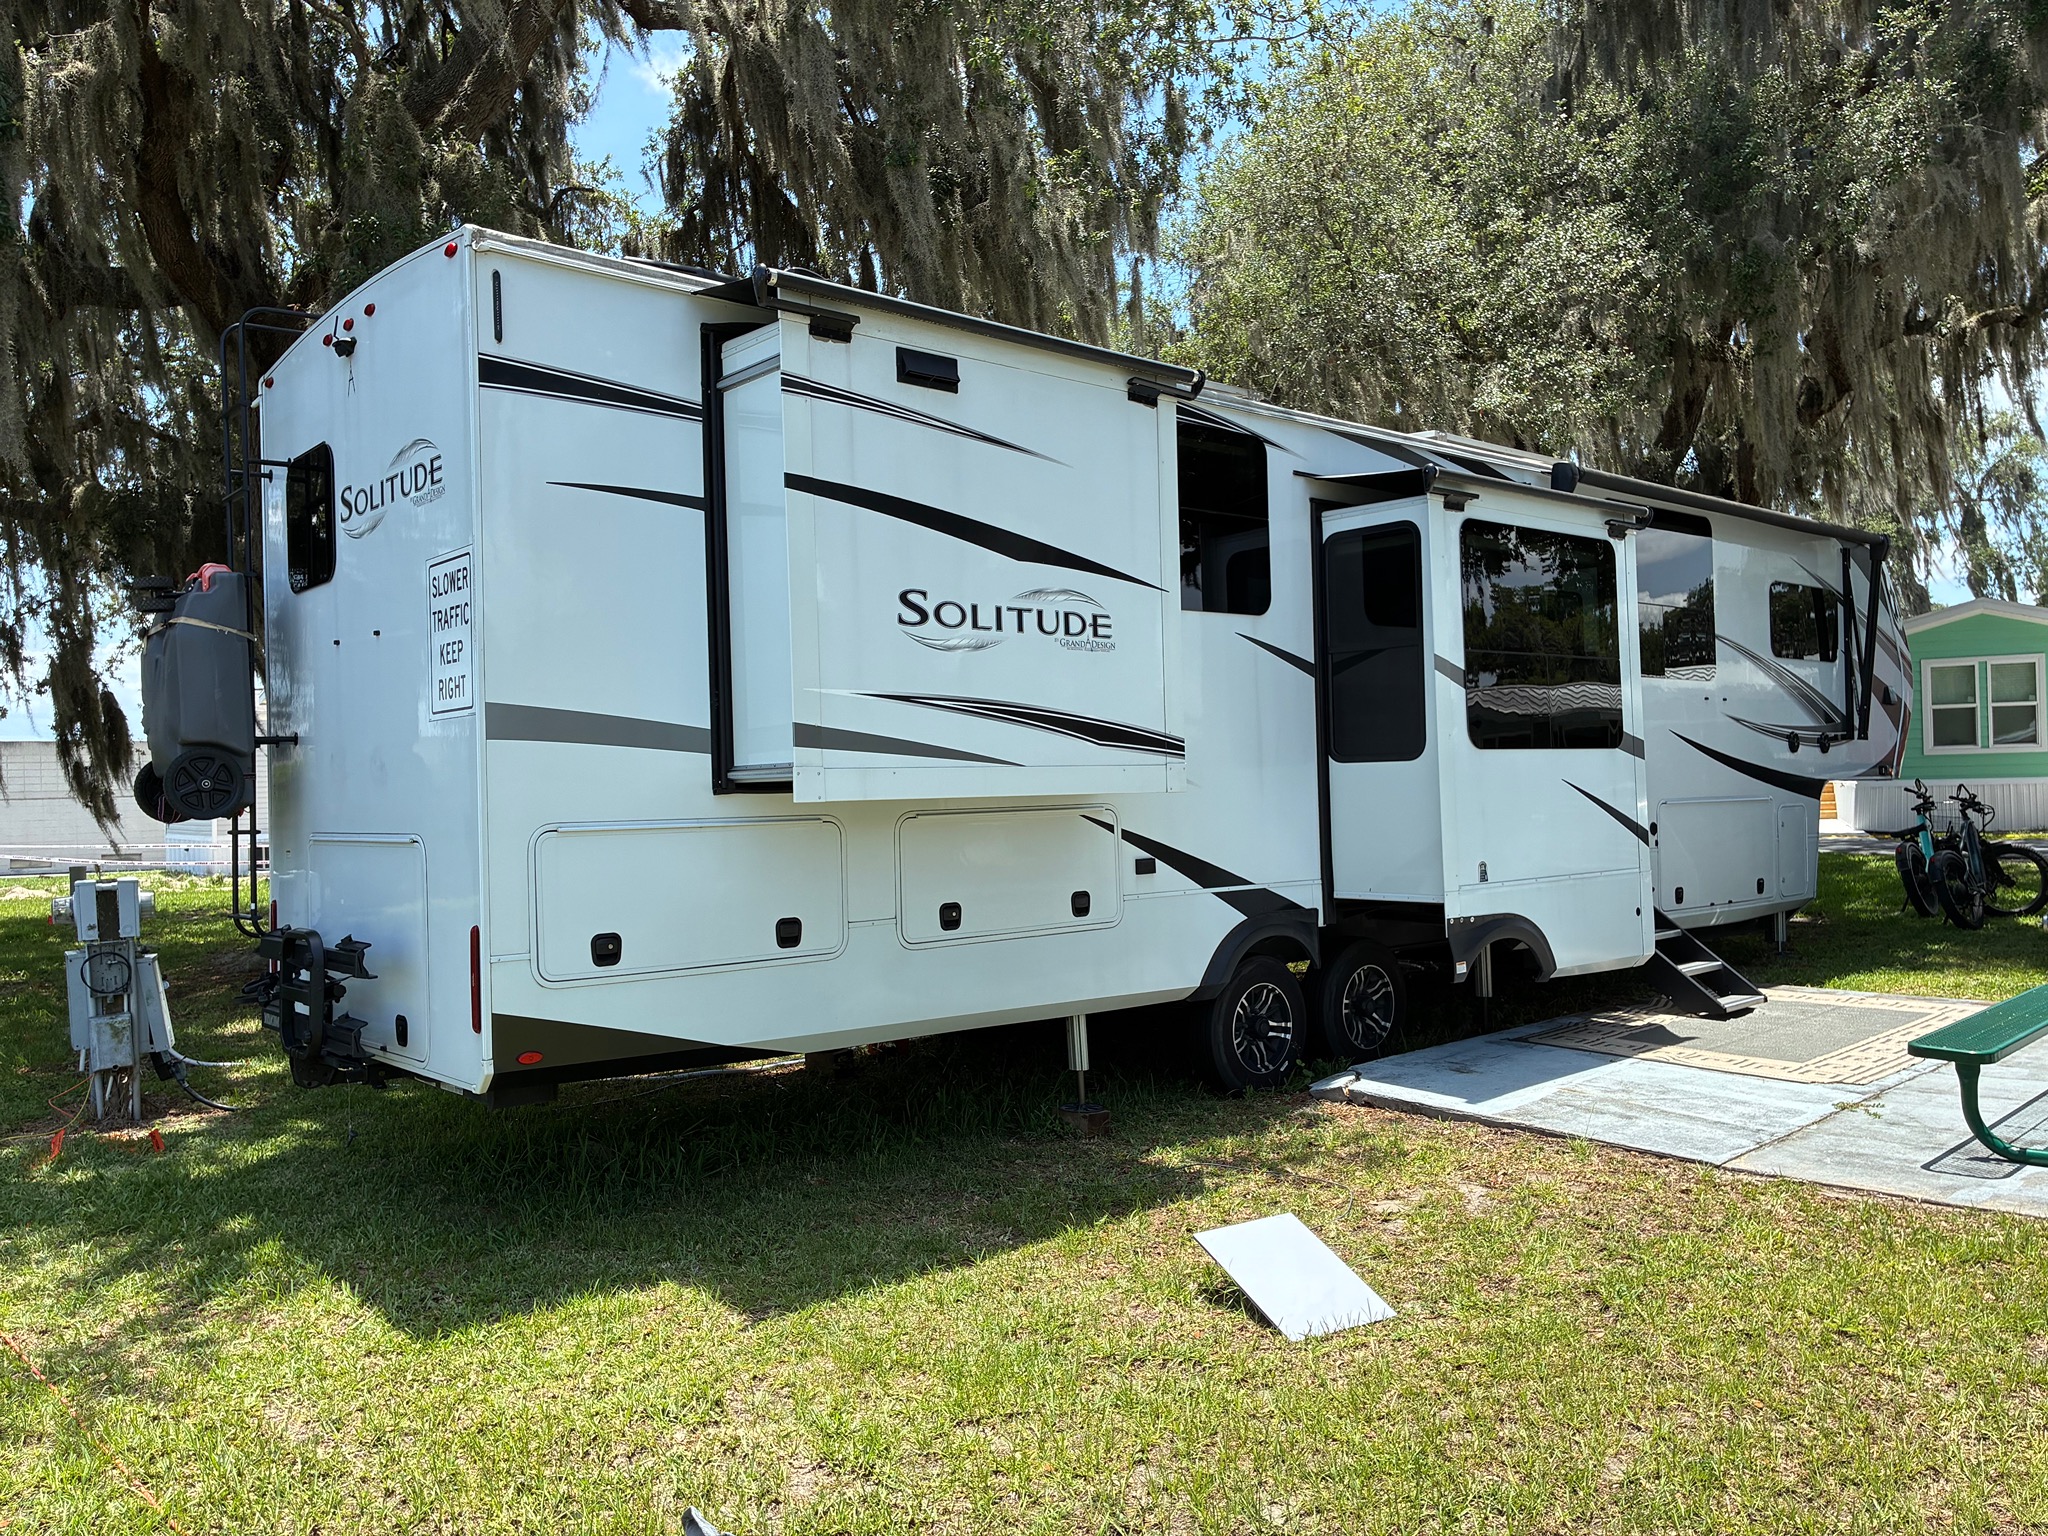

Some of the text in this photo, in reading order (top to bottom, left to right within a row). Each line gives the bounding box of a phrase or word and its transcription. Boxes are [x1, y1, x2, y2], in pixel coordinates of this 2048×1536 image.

[340, 453, 443, 523] SOLITUDE
[432, 566, 469, 599] SLOWER
[432, 602, 470, 633] TRAFFIC
[897, 588, 1112, 639] SOLITUDE
[439, 639, 464, 666] KEEP
[1059, 638, 1086, 648] GRAND
[1091, 639, 1116, 650] DESIGN
[438, 674, 466, 701] RIGHT
